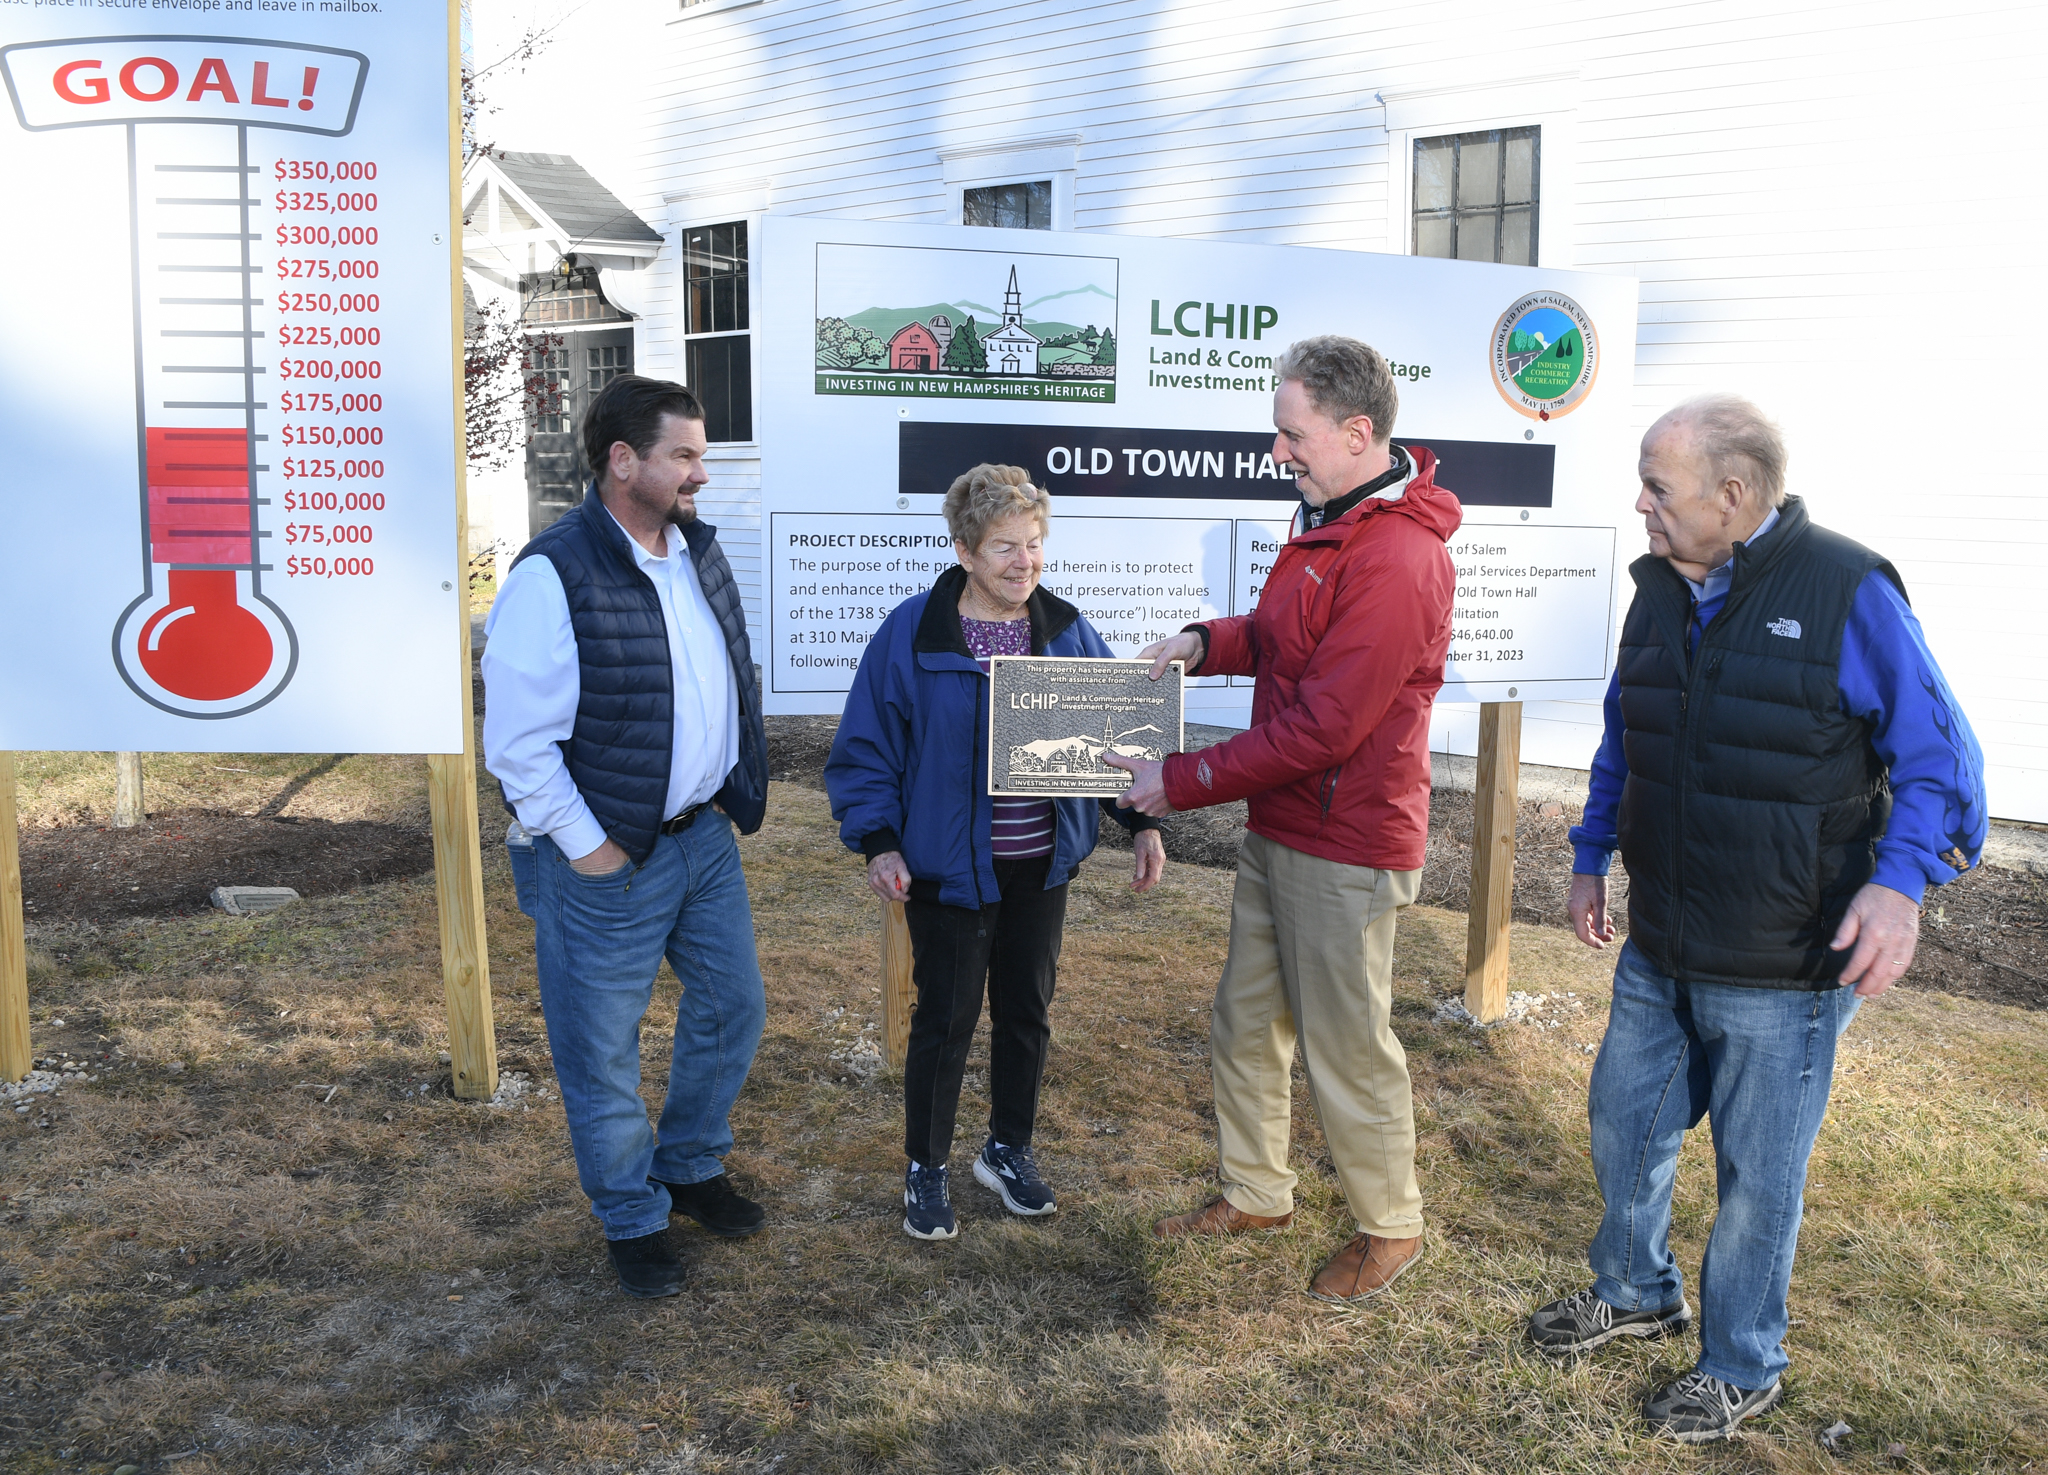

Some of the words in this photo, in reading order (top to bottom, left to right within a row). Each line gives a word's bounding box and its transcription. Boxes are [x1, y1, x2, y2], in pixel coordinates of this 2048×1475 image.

[98, 0, 147, 8] secure
[152, 0, 221, 12] envelope
[225, 0, 252, 11] and
[258, 0, 297, 11] leave
[302, 0, 314, 12] in
[320, 0, 383, 13] mailbox.
[52, 56, 320, 111] GOAL!
[274, 158, 377, 183] $350,000
[275, 189, 378, 215] $325,000
[276, 223, 379, 248] $300,000
[277, 257, 379, 282] $275,000
[278, 290, 380, 315] $250,000
[1515, 297, 1538, 314] TOWN
[1548, 296, 1575, 315] SALEM,
[1150, 299, 1279, 341] LCHIP
[1574, 313, 1588, 334] NEW
[279, 323, 381, 348] $225,000
[1149, 346, 1201, 366] Land
[1206, 349, 1222, 367] &
[1496, 312, 1516, 383] INCORPORATED
[1537, 361, 1571, 370] INDUSTRY
[1580, 332, 1594, 386] HAMPSHIRE
[280, 357, 382, 382] $200,000
[1530, 369, 1571, 378] COMMERCE
[825, 377, 897, 392] INVESTING
[901, 381, 913, 392] IN
[918, 380, 949, 393] NEW
[953, 381, 1041, 396] HAMPSHIRE'S
[1044, 385, 1106, 398] HERITAGE
[1149, 369, 1265, 392] Investment
[1525, 377, 1568, 385] RECREATION
[281, 390, 383, 415] $175,000
[1521, 395, 1537, 409] MAY
[1550, 398, 1565, 409] 1750
[282, 424, 383, 448] $150,000
[282, 458, 385, 482] $125,000
[1047, 446, 1113, 475] OLD
[1122, 449, 1224, 478] TOWN
[1235, 452, 1299, 480] HAL
[284, 490, 386, 514] $100,000
[285, 522, 373, 547] $75,000
[789, 534, 856, 547] PROJECT
[1456, 543, 1469, 555] of
[1471, 544, 1507, 555] Salem
[286, 555, 374, 579] $50,000
[789, 558, 816, 572] The
[821, 561, 882, 574] purpose
[886, 558, 901, 572] of
[905, 559, 929, 572] the
[1063, 560, 1107, 573] herein
[1111, 561, 1121, 573] is
[1126, 562, 1140, 574] to
[1144, 563, 1194, 576] protect
[1480, 566, 1527, 577] Services
[1529, 566, 1596, 579] Department
[789, 582, 817, 595] and
[821, 582, 884, 595] enhance
[888, 583, 913, 595] the
[1048, 583, 1073, 596] and
[1077, 584, 1164, 598] preservation
[1168, 584, 1210, 597] values
[1457, 586, 1477, 598] Old
[1481, 586, 1512, 598] Town
[1515, 586, 1537, 598] Hall
[789, 606, 805, 619] of
[808, 606, 834, 619] the
[838, 607, 874, 619] 1738
[1150, 606, 1200, 619] located
[1452, 608, 1499, 619] ilitation
[1778, 617, 1792, 626] THE
[1766, 621, 1790, 631] NORTH
[1771, 628, 1789, 637] FACE
[789, 632, 804, 644] at
[809, 631, 836, 644] 310
[1144, 631, 1167, 642] the
[790, 654, 858, 670] following
[1475, 650, 1493, 662] 31,
[1496, 650, 1524, 661] 2023
[1044, 665, 1076, 674] property
[1078, 665, 1091, 673] has
[1093, 666, 1111, 674] been
[1114, 667, 1150, 675] protected
[1011, 692, 1058, 710] LCHIP
[1088, 695, 1131, 704] Community
[1134, 696, 1165, 705] Heritage
[1105, 704, 1136, 712] Program
[1060, 779, 1076, 787] NEW
